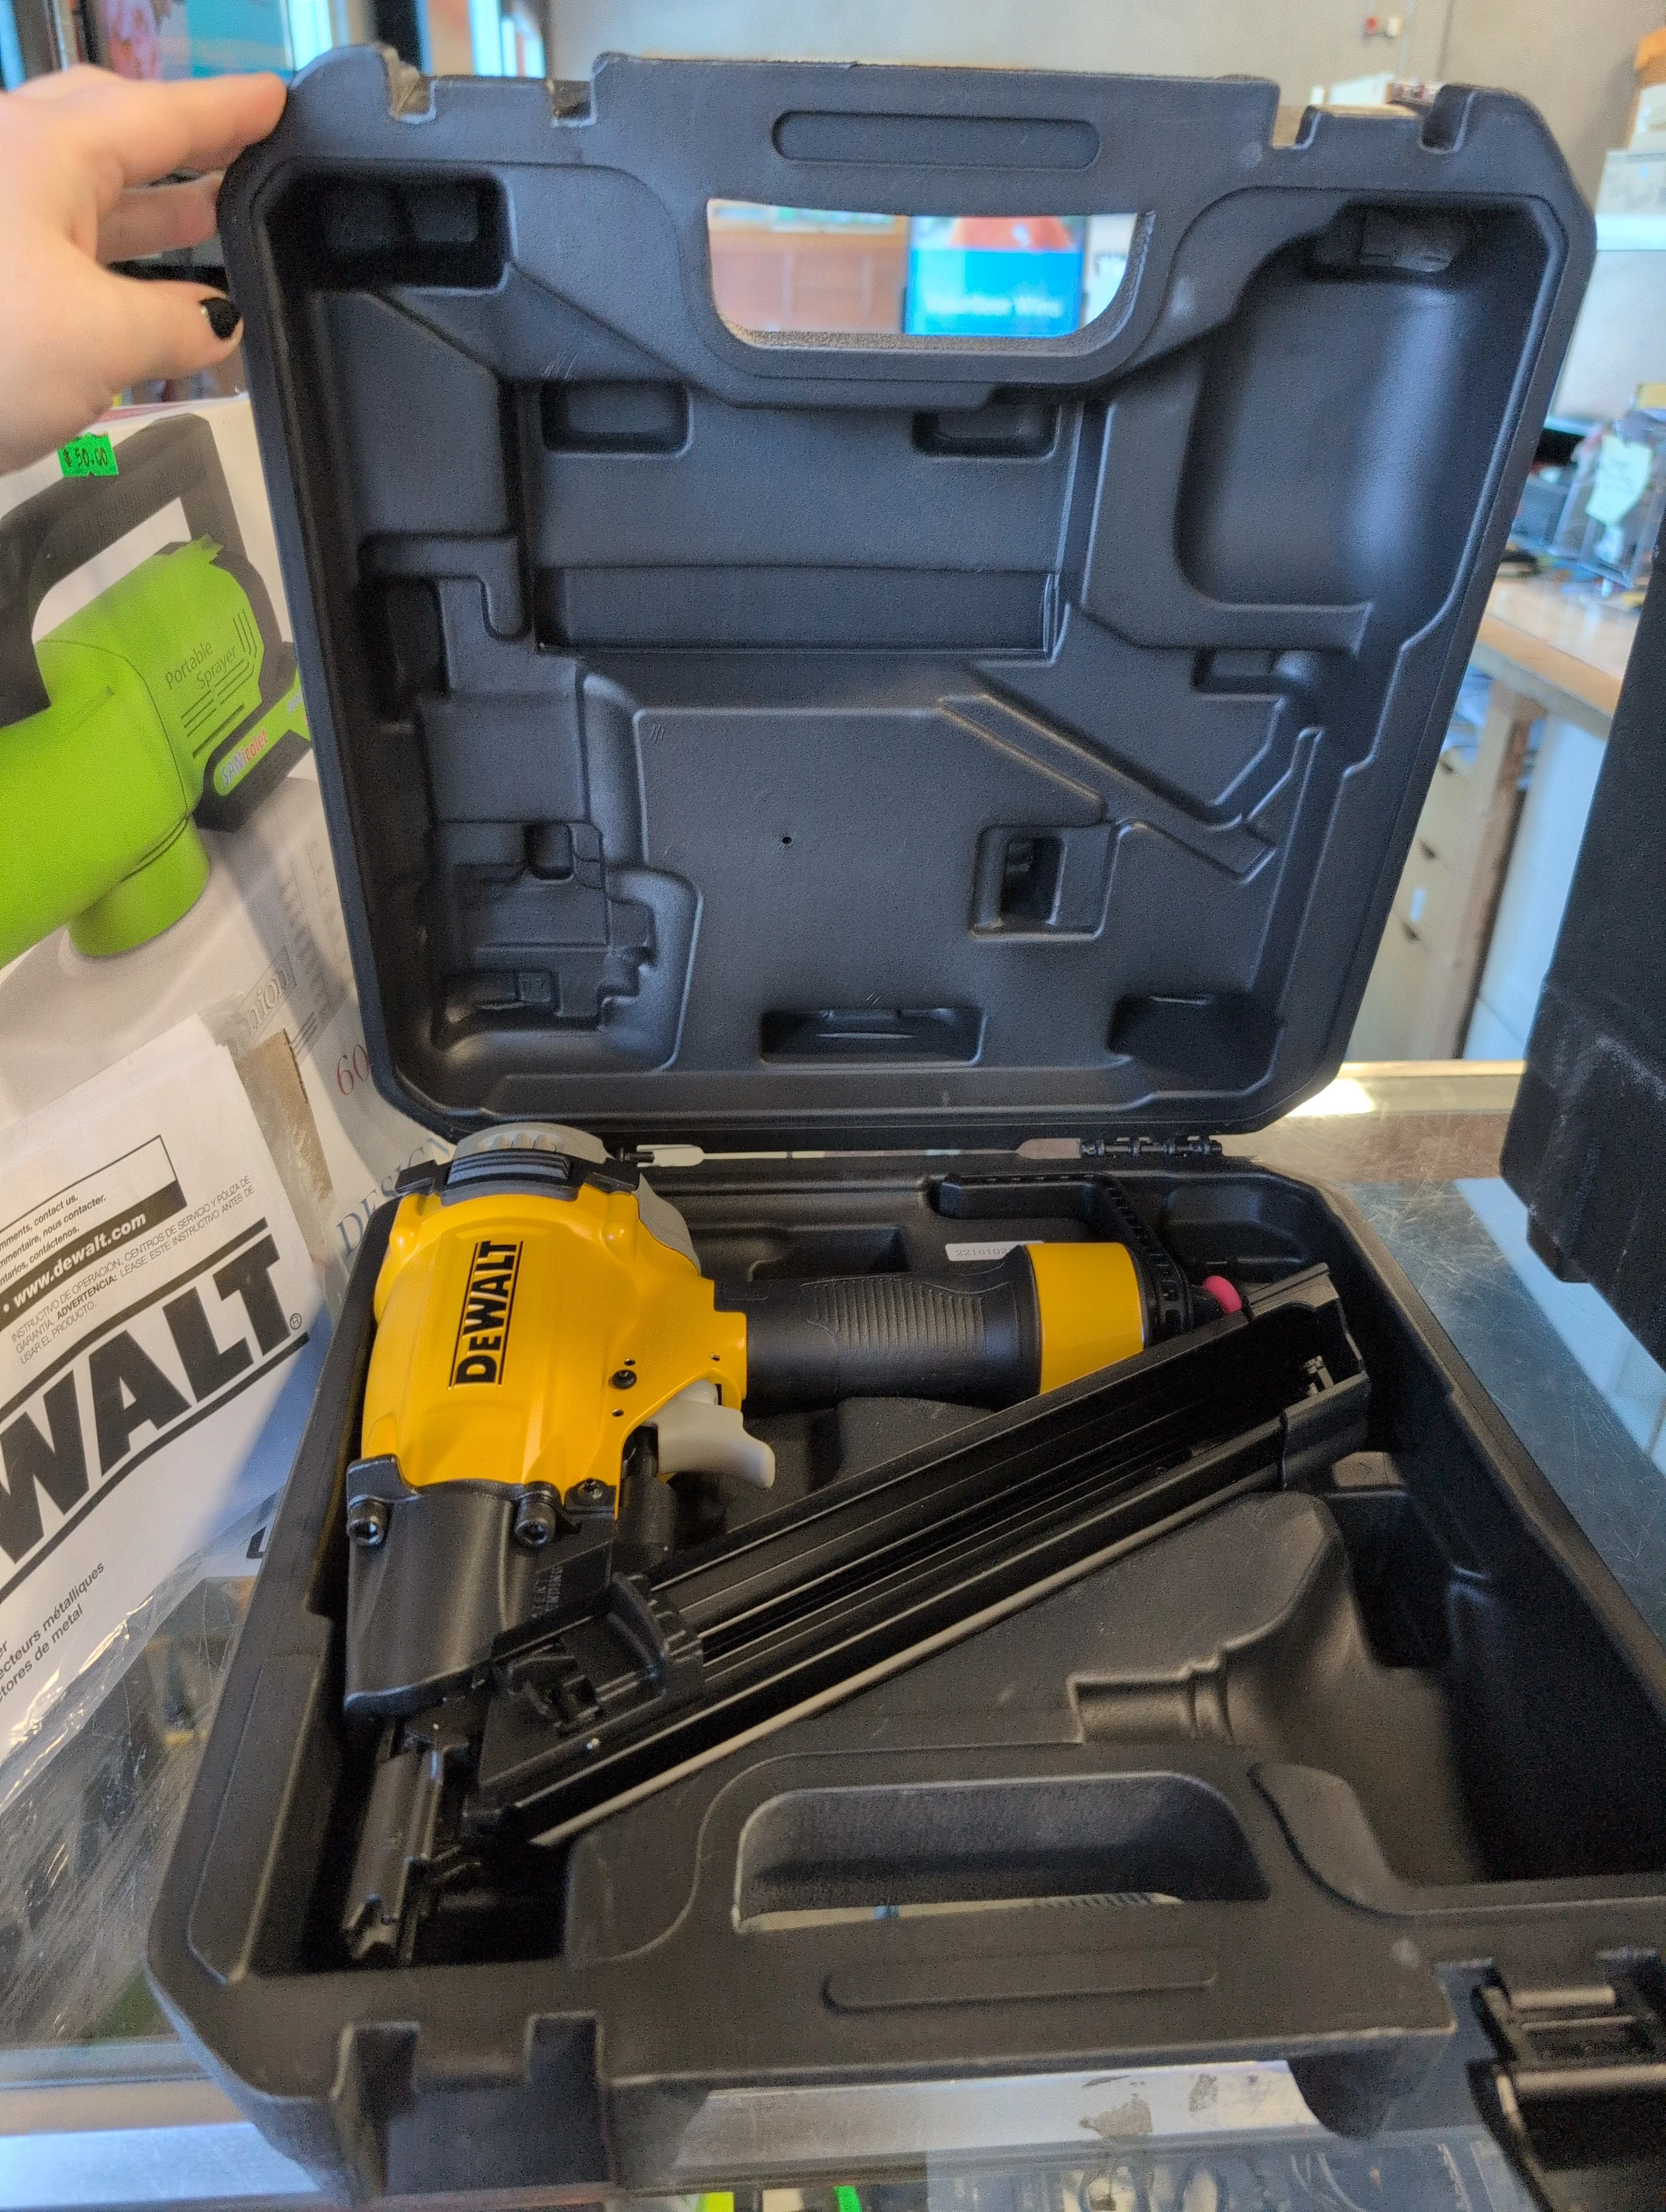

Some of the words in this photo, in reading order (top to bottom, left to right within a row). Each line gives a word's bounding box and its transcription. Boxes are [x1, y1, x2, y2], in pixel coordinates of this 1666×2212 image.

[165, 641, 214, 691] Portable
[196, 646, 236, 690] Sprayer
[337, 1044, 370, 1096] 60
[34, 1201, 65, 1226] contact
[43, 1219, 62, 1238] nous
[11, 1298, 59, 1343] INSTRUCTIVO
[60, 1289, 72, 1304] DE
[72, 1257, 124, 1295] OPERACIÓN,
[124, 1232, 165, 1262] CENTROS
[165, 1225, 178, 1238] DE
[177, 1203, 210, 1230] SERVICIO
[211, 1198, 217, 1207] Y
[217, 1183, 241, 1205] PÓLIZA
[240, 1175, 251, 1188] DE
[13, 1213, 146, 1308] www.dewalt.com
[29, 1226, 80, 1263] contáctenos.
[57, 1274, 118, 1321] ADVERTENCIA:
[120, 1255, 149, 1278] LÉASE
[149, 1241, 171, 1260] ESTE
[172, 1210, 220, 1246] INSTRUCTIVO
[221, 1195, 244, 1214] ANTES
[244, 1185, 255, 1198] DE
[41, 1336, 53, 1347] EL
[52, 1300, 97, 1339] PRODUCTO.
[453, 1240, 517, 1386] DEWALT
[42, 1562, 105, 1632] métalliques
[34, 1642, 50, 1661] de
[51, 1603, 84, 1644] metal
